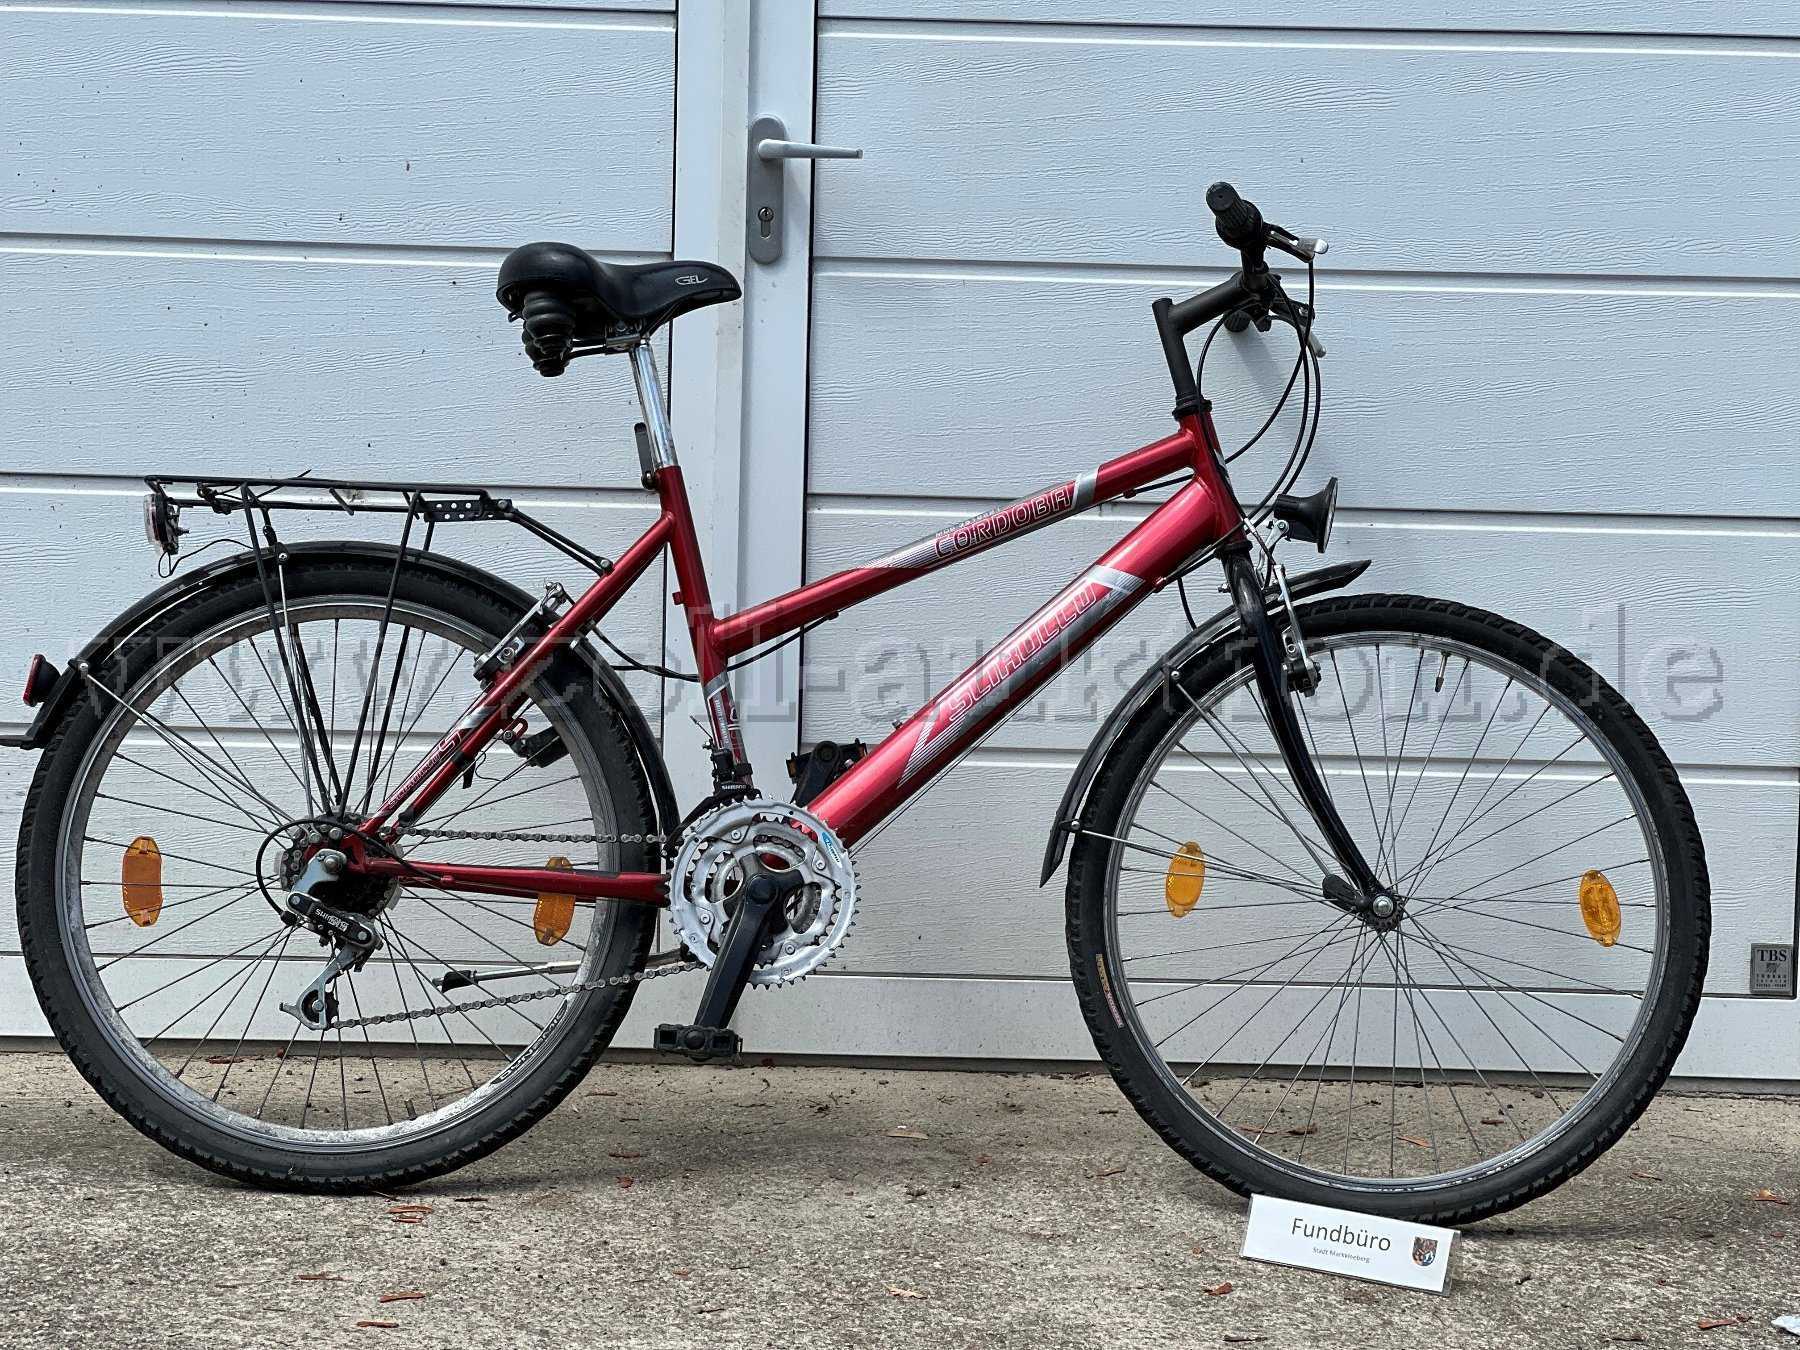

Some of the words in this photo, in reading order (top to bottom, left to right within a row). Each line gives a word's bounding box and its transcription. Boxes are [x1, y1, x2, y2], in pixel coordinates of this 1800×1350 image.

[674, 274, 708, 286] GEL
[934, 485, 1072, 558] CORDOBA
[1757, 949, 1787, 961] TBS
[1291, 1218, 1391, 1251] Fundbüro
